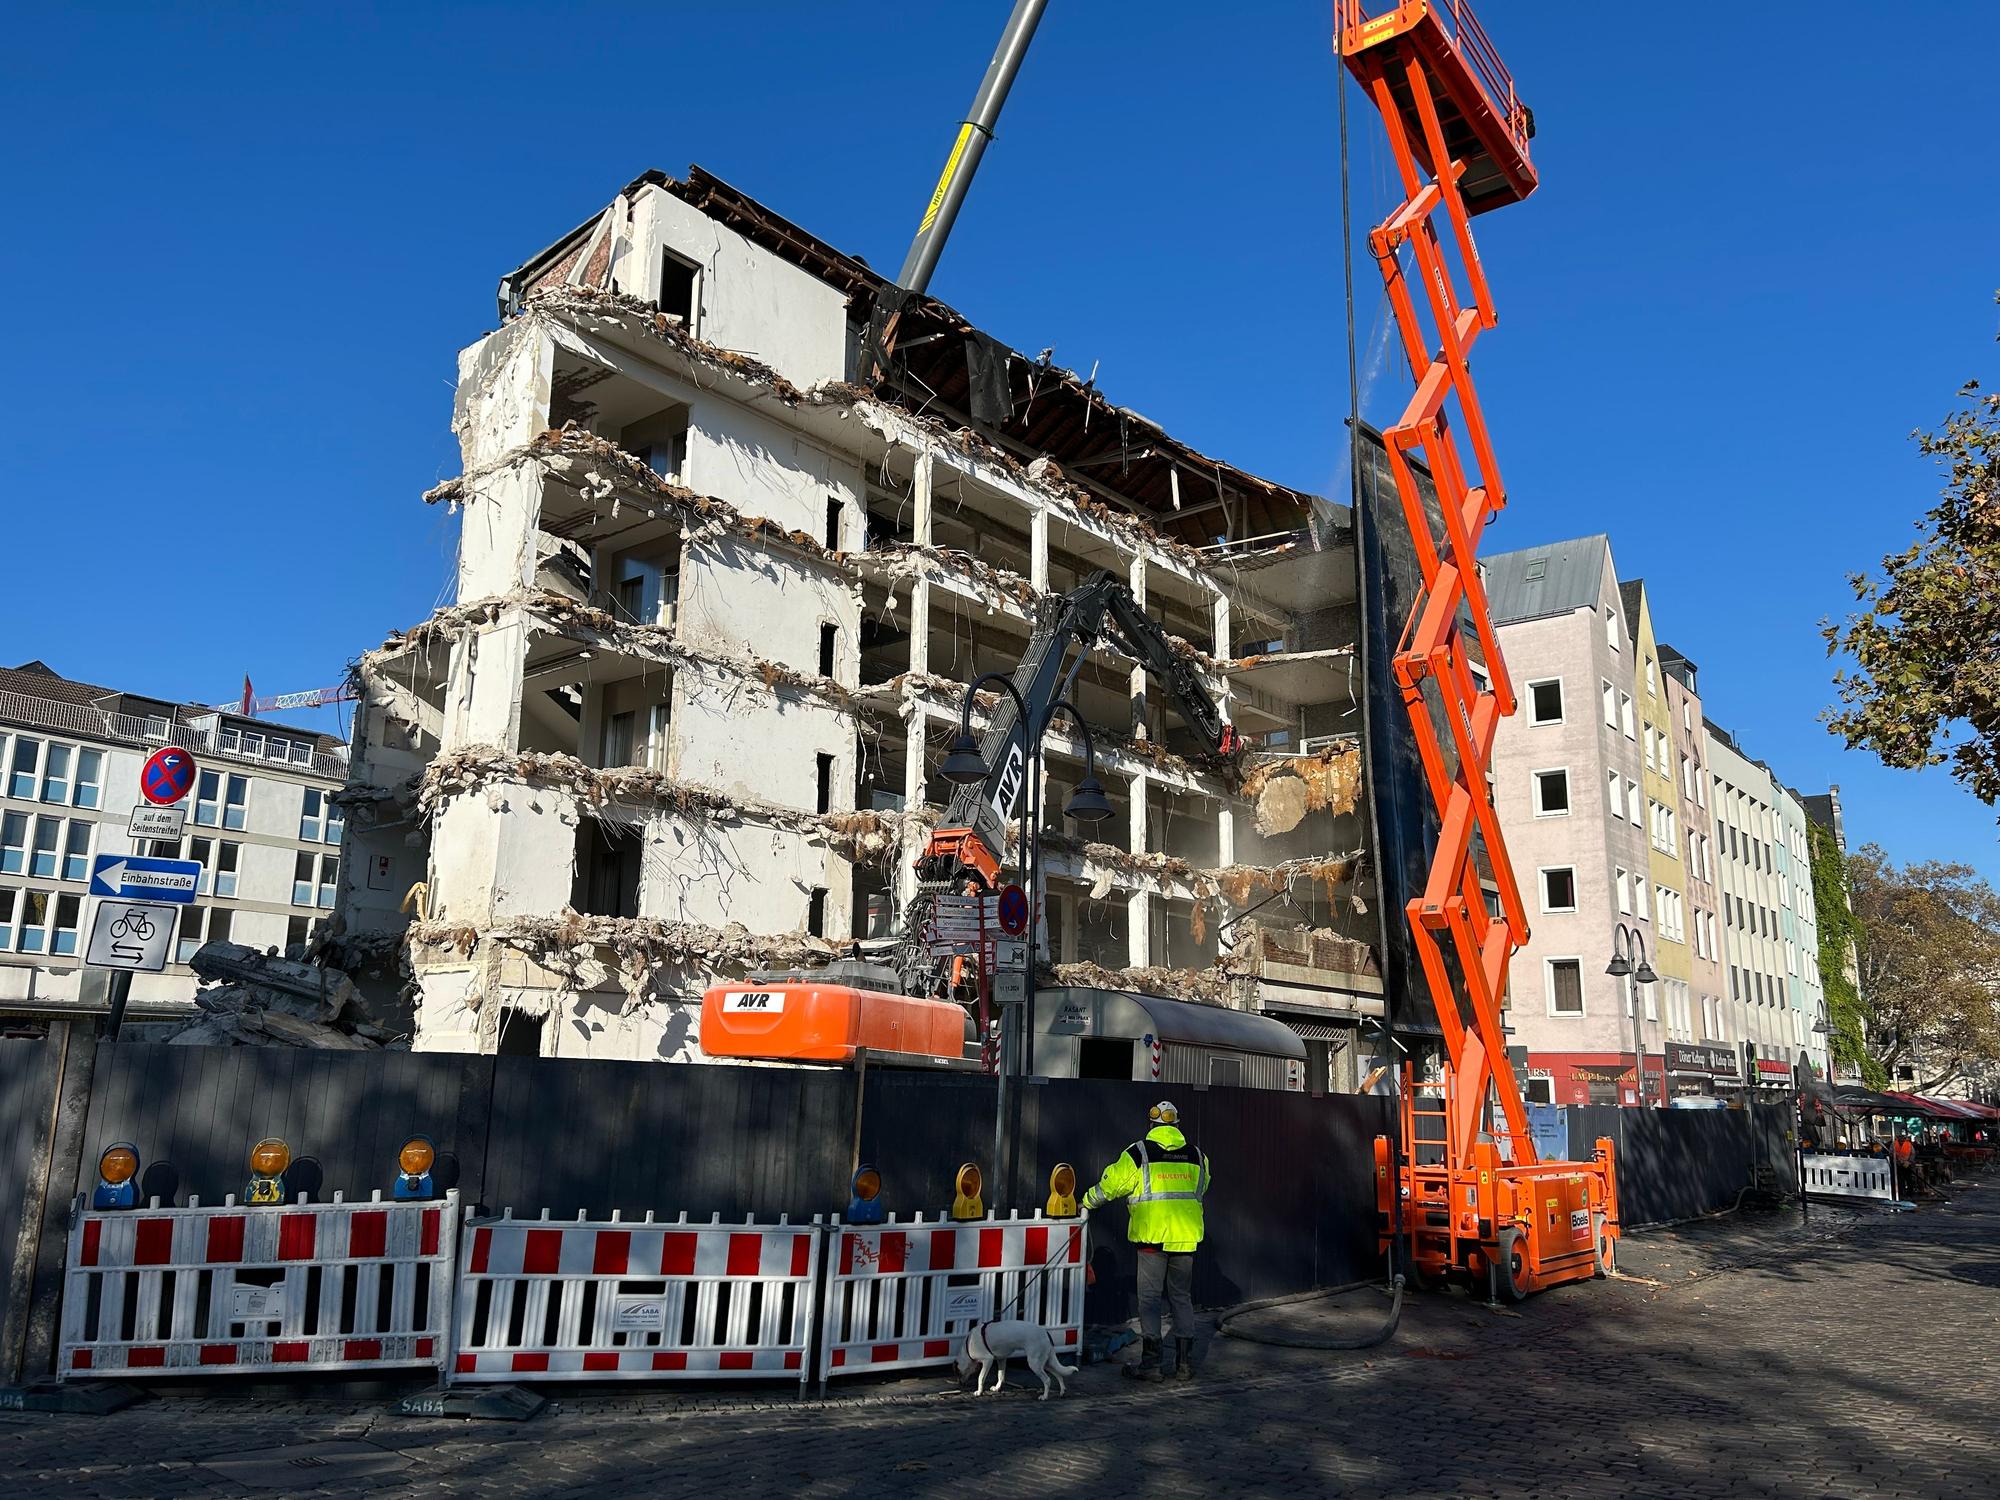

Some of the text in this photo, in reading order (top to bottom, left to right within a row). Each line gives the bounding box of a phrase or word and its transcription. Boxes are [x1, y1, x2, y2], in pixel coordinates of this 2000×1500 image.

[932, 186, 943, 206] HKV
[998, 752, 1023, 817] AVR
[143, 813, 172, 823] auf dem
[132, 822, 178, 835] Seitenstreifen
[121, 872, 192, 887] Einbahnstraße
[737, 993, 770, 1008] AVR
[1527, 1068, 1552, 1077] URST
[1571, 1212, 1589, 1228] Boels
[402, 1399, 443, 1412] SABA
